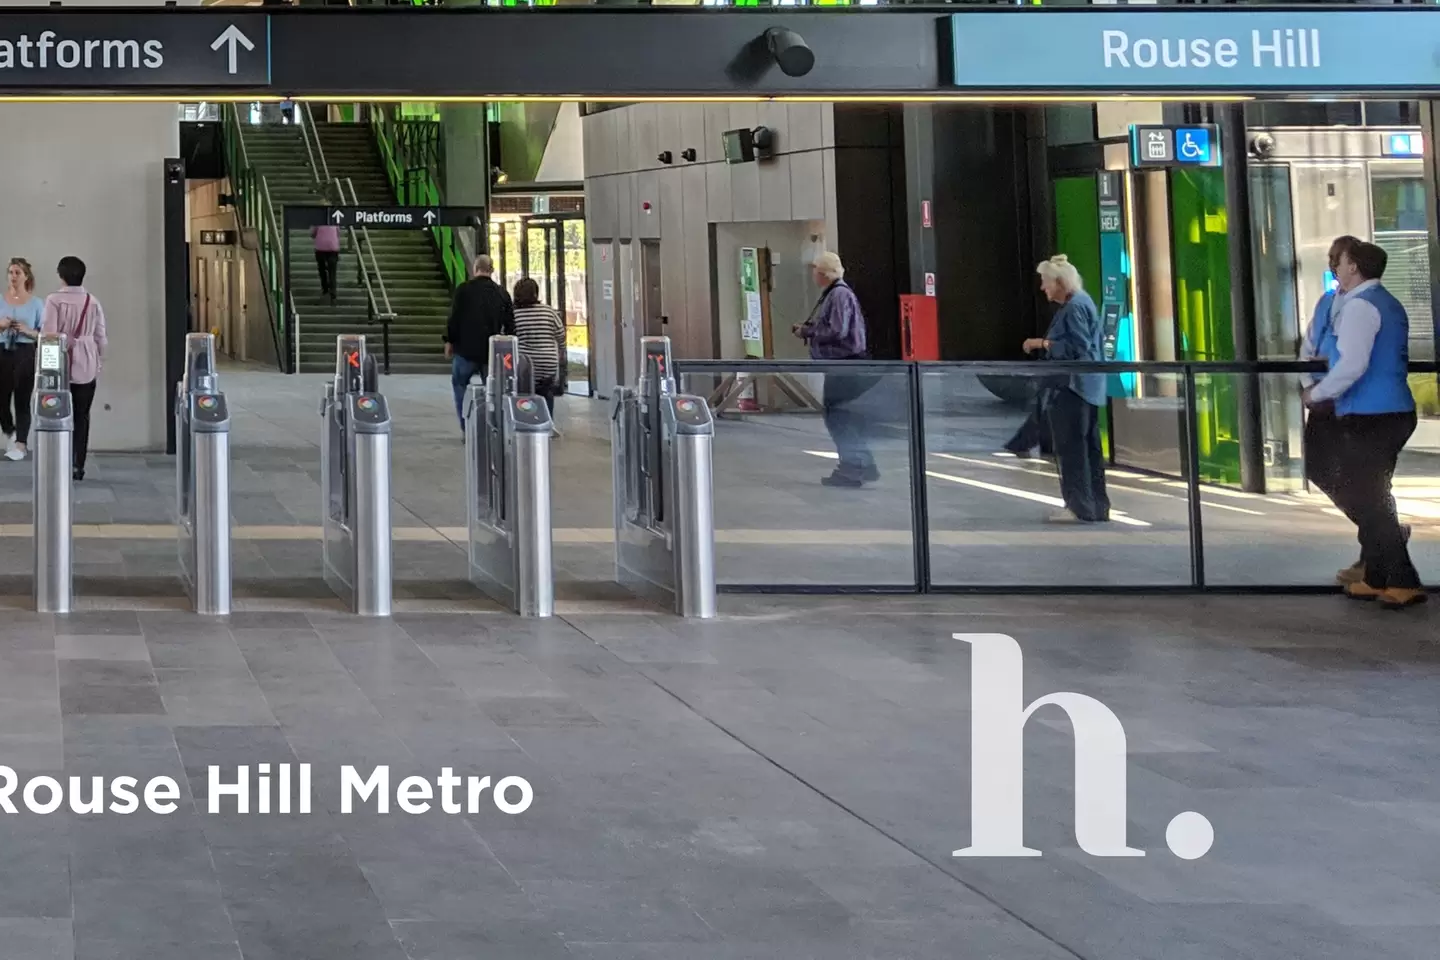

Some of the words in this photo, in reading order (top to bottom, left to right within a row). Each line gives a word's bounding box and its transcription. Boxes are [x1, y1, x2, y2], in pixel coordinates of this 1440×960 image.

[1103, 30, 1238, 68] Rouse
[1252, 28, 1321, 67] Hill
[355, 211, 413, 223] Platforms
